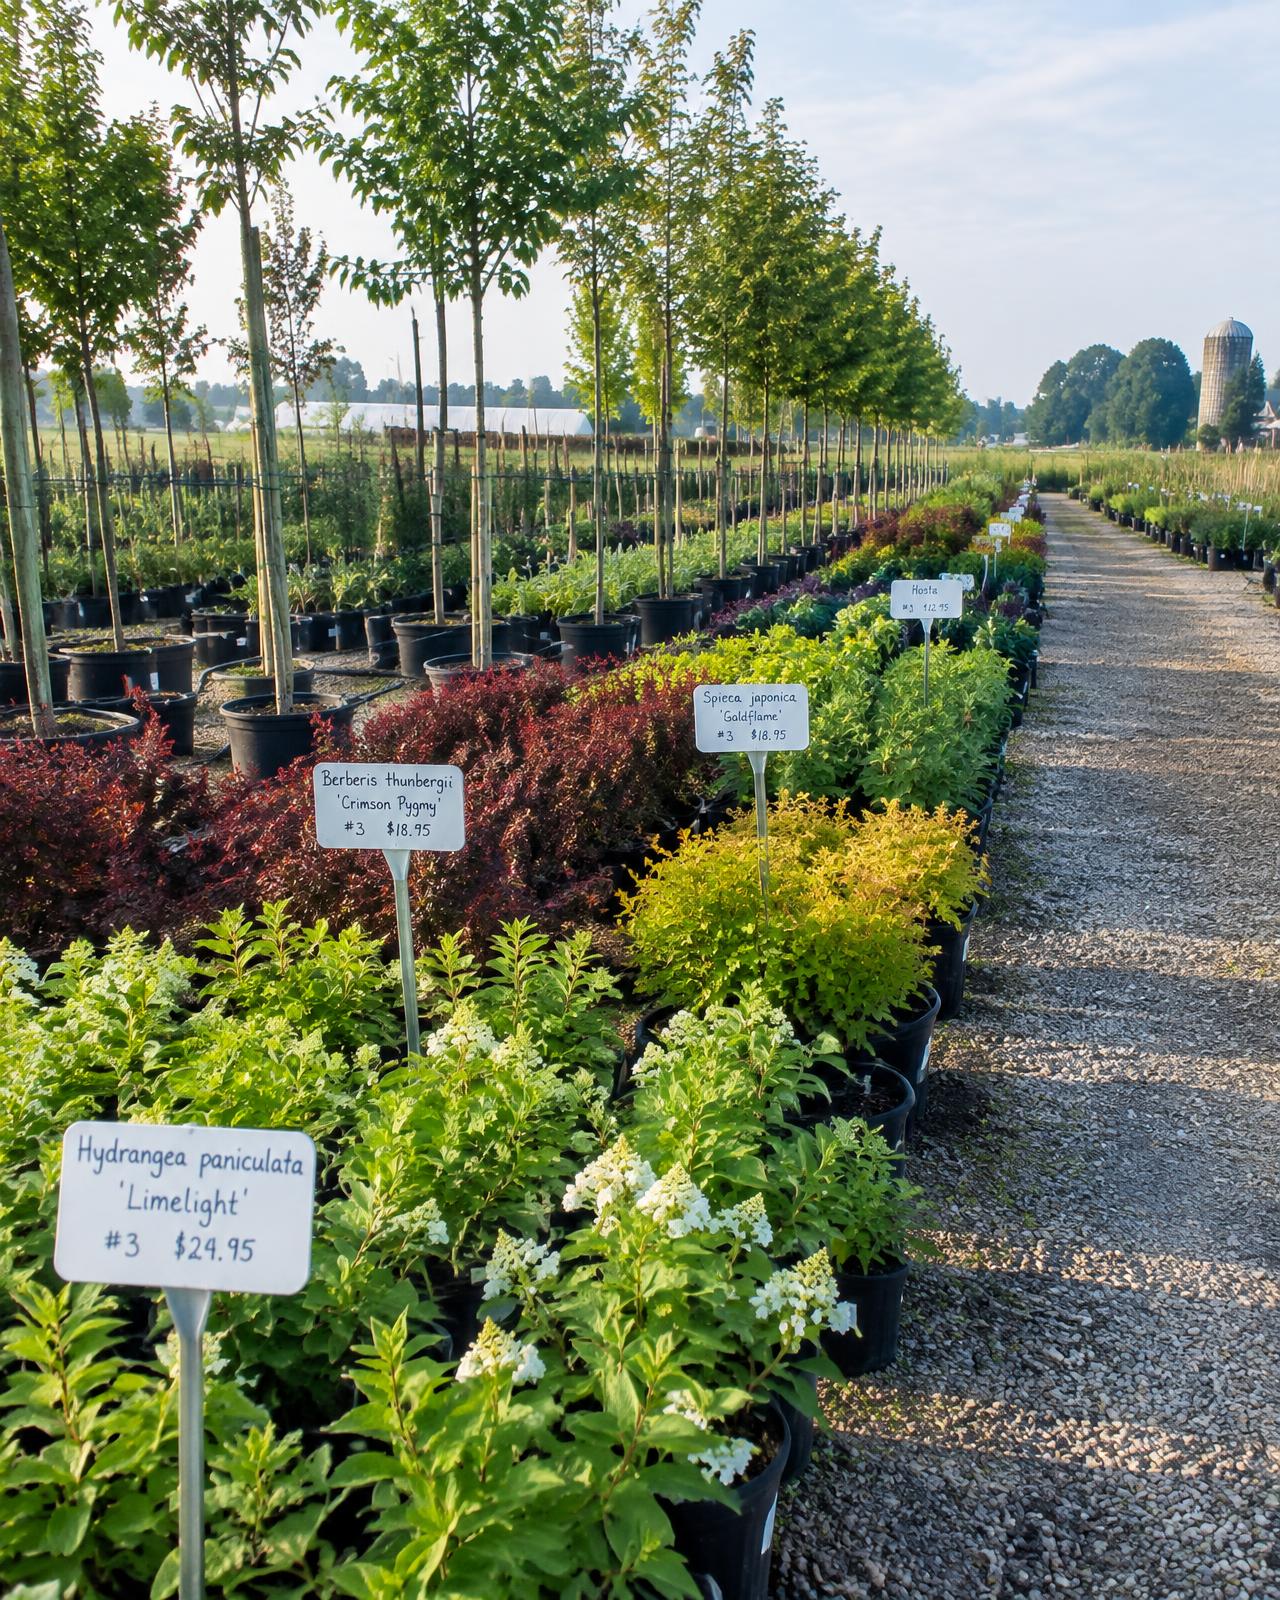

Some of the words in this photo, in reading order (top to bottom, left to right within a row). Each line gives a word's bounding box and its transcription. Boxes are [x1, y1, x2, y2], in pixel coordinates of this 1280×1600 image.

[749, 691, 798, 709] japonica
[716, 729, 734, 742] #3
[751, 728, 787, 742] $18.95
[321, 769, 378, 787] Berberis
[385, 771, 453, 795] thunbergii
[337, 793, 392, 811] 'Crimson
[396, 795, 442, 818] Pygmy'
[343, 819, 366, 837] #3
[386, 820, 433, 838] $18.95
[78, 1135, 187, 1178] Hydrangea
[199, 1147, 304, 1178] paniculata
[119, 1180, 249, 1228] 'Limelight'
[104, 1230, 140, 1258] #3
[174, 1230, 256, 1263] $24.95
